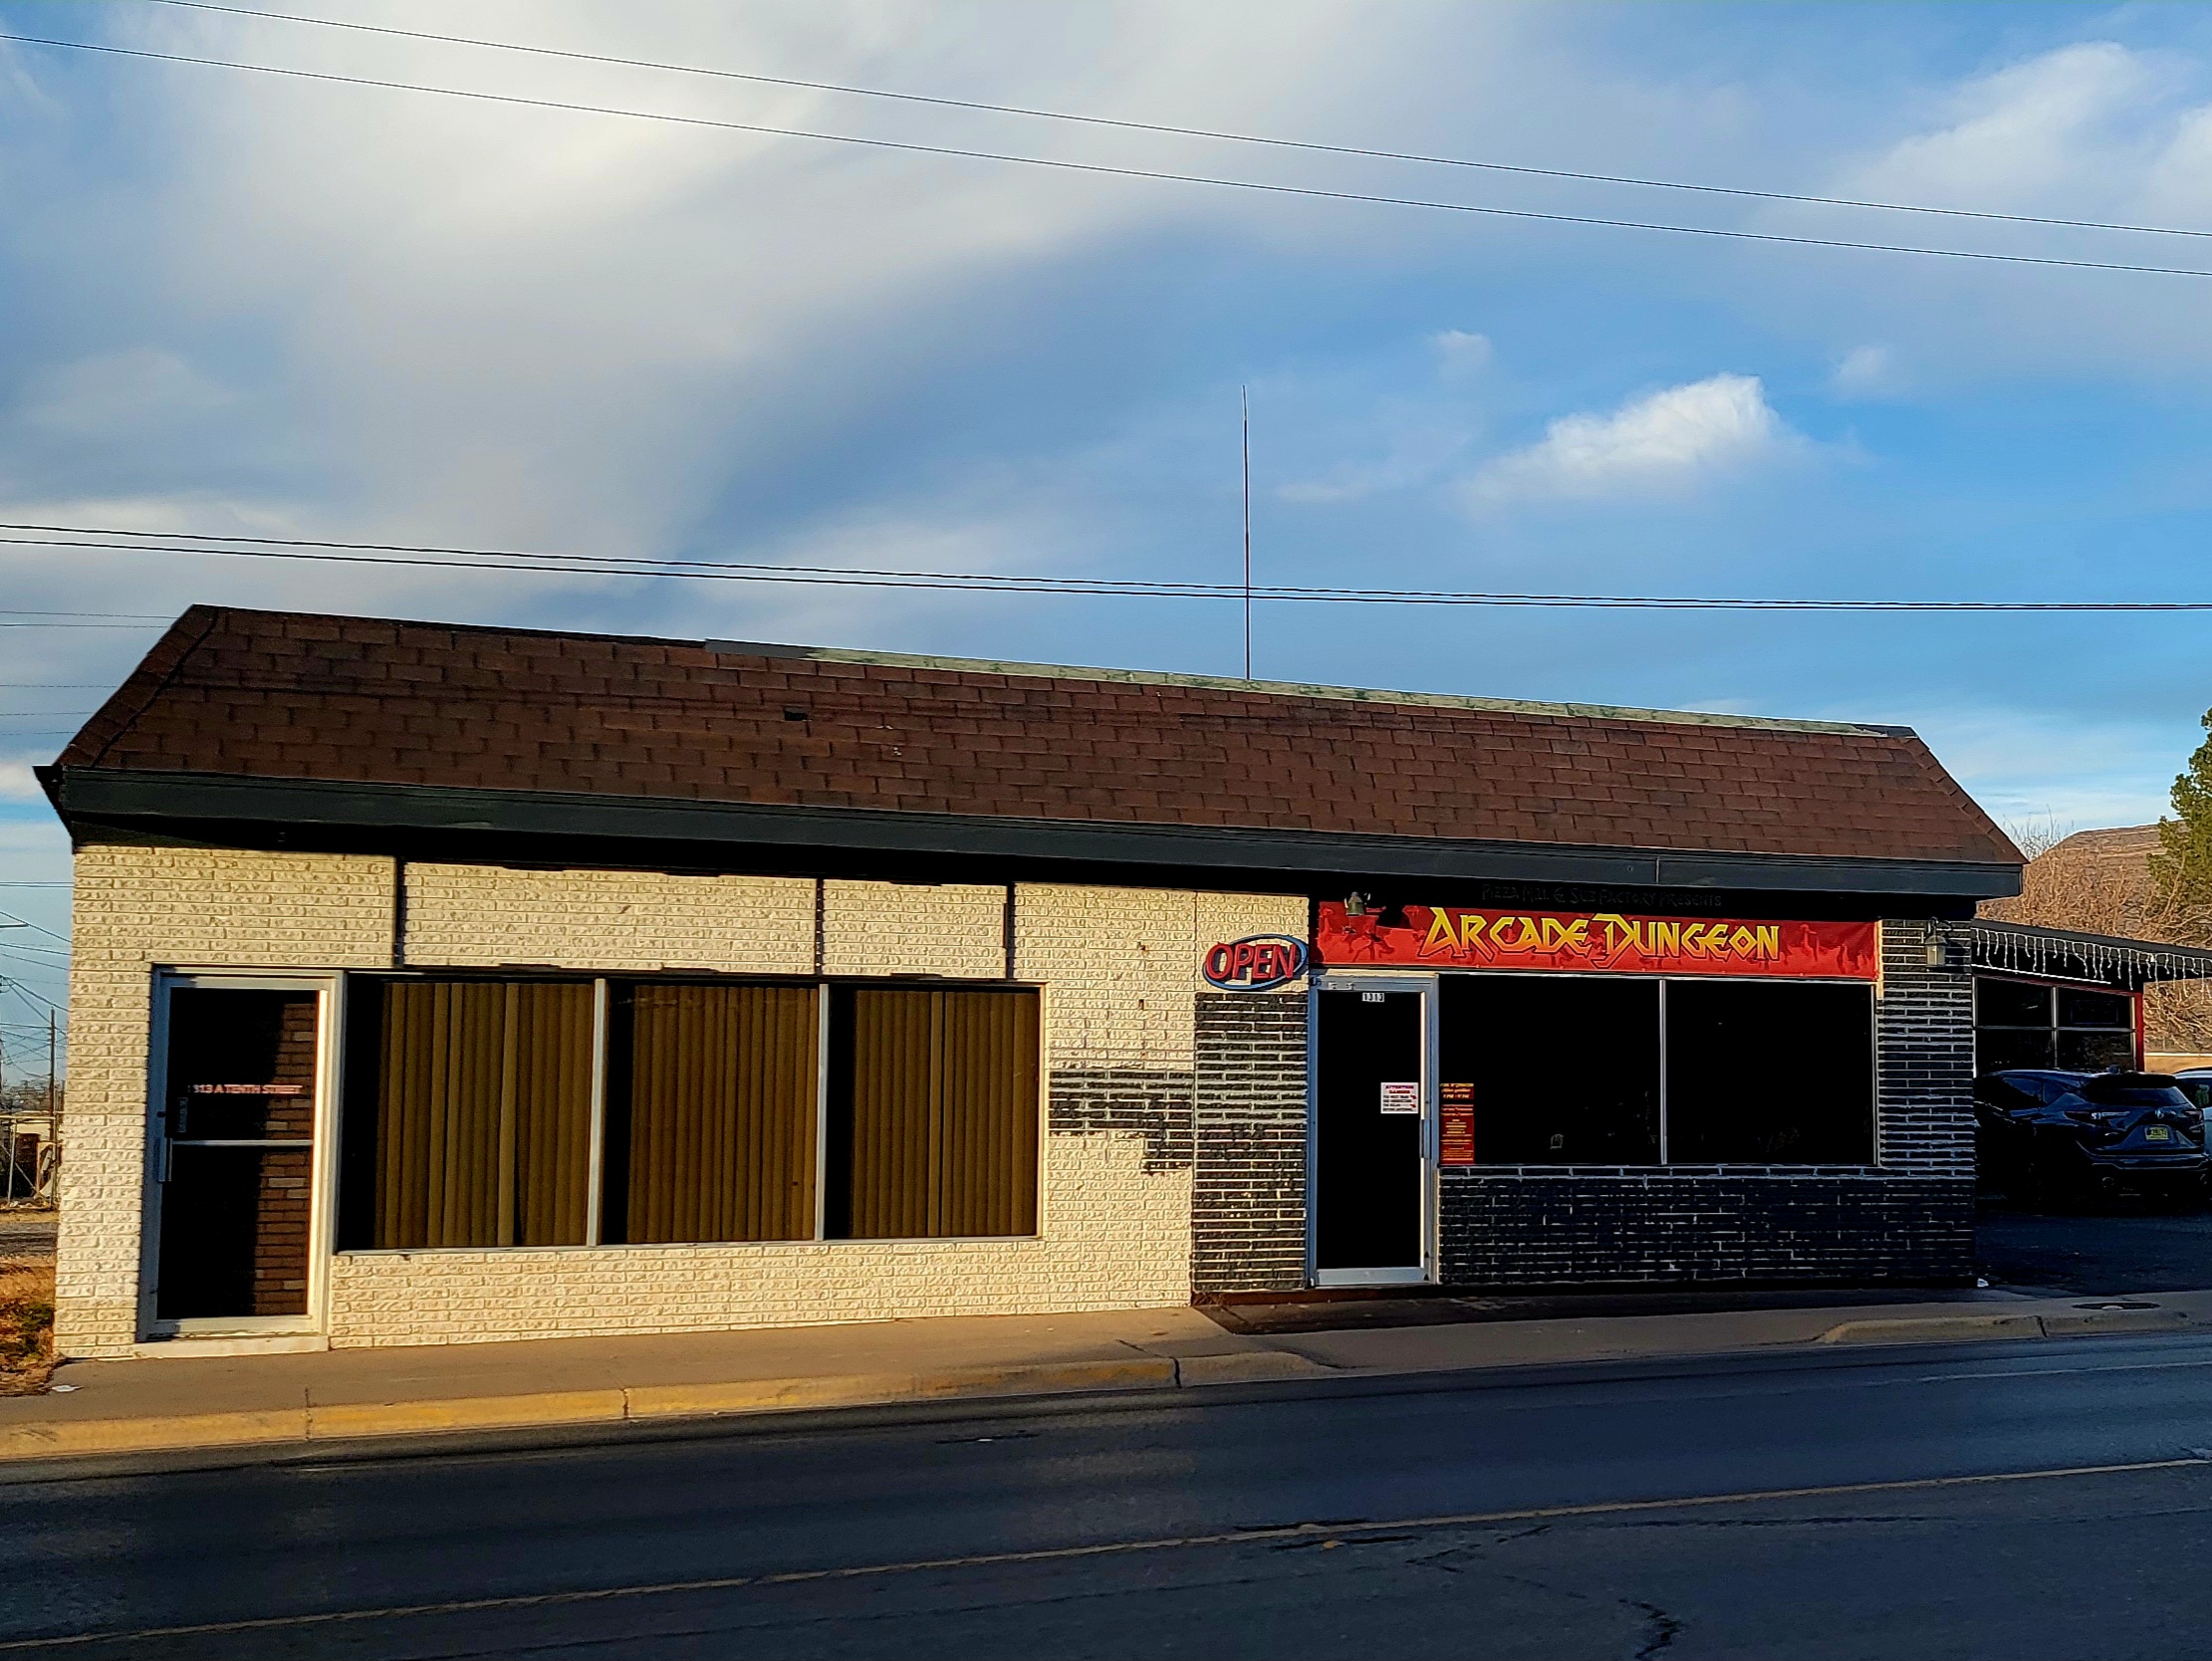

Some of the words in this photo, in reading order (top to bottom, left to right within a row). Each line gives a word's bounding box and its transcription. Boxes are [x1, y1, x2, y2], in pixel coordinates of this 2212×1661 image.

[1205, 942, 1298, 980] OPEN
[1418, 906, 1593, 962] ARCADE
[1591, 912, 1783, 969] DUNGEON
